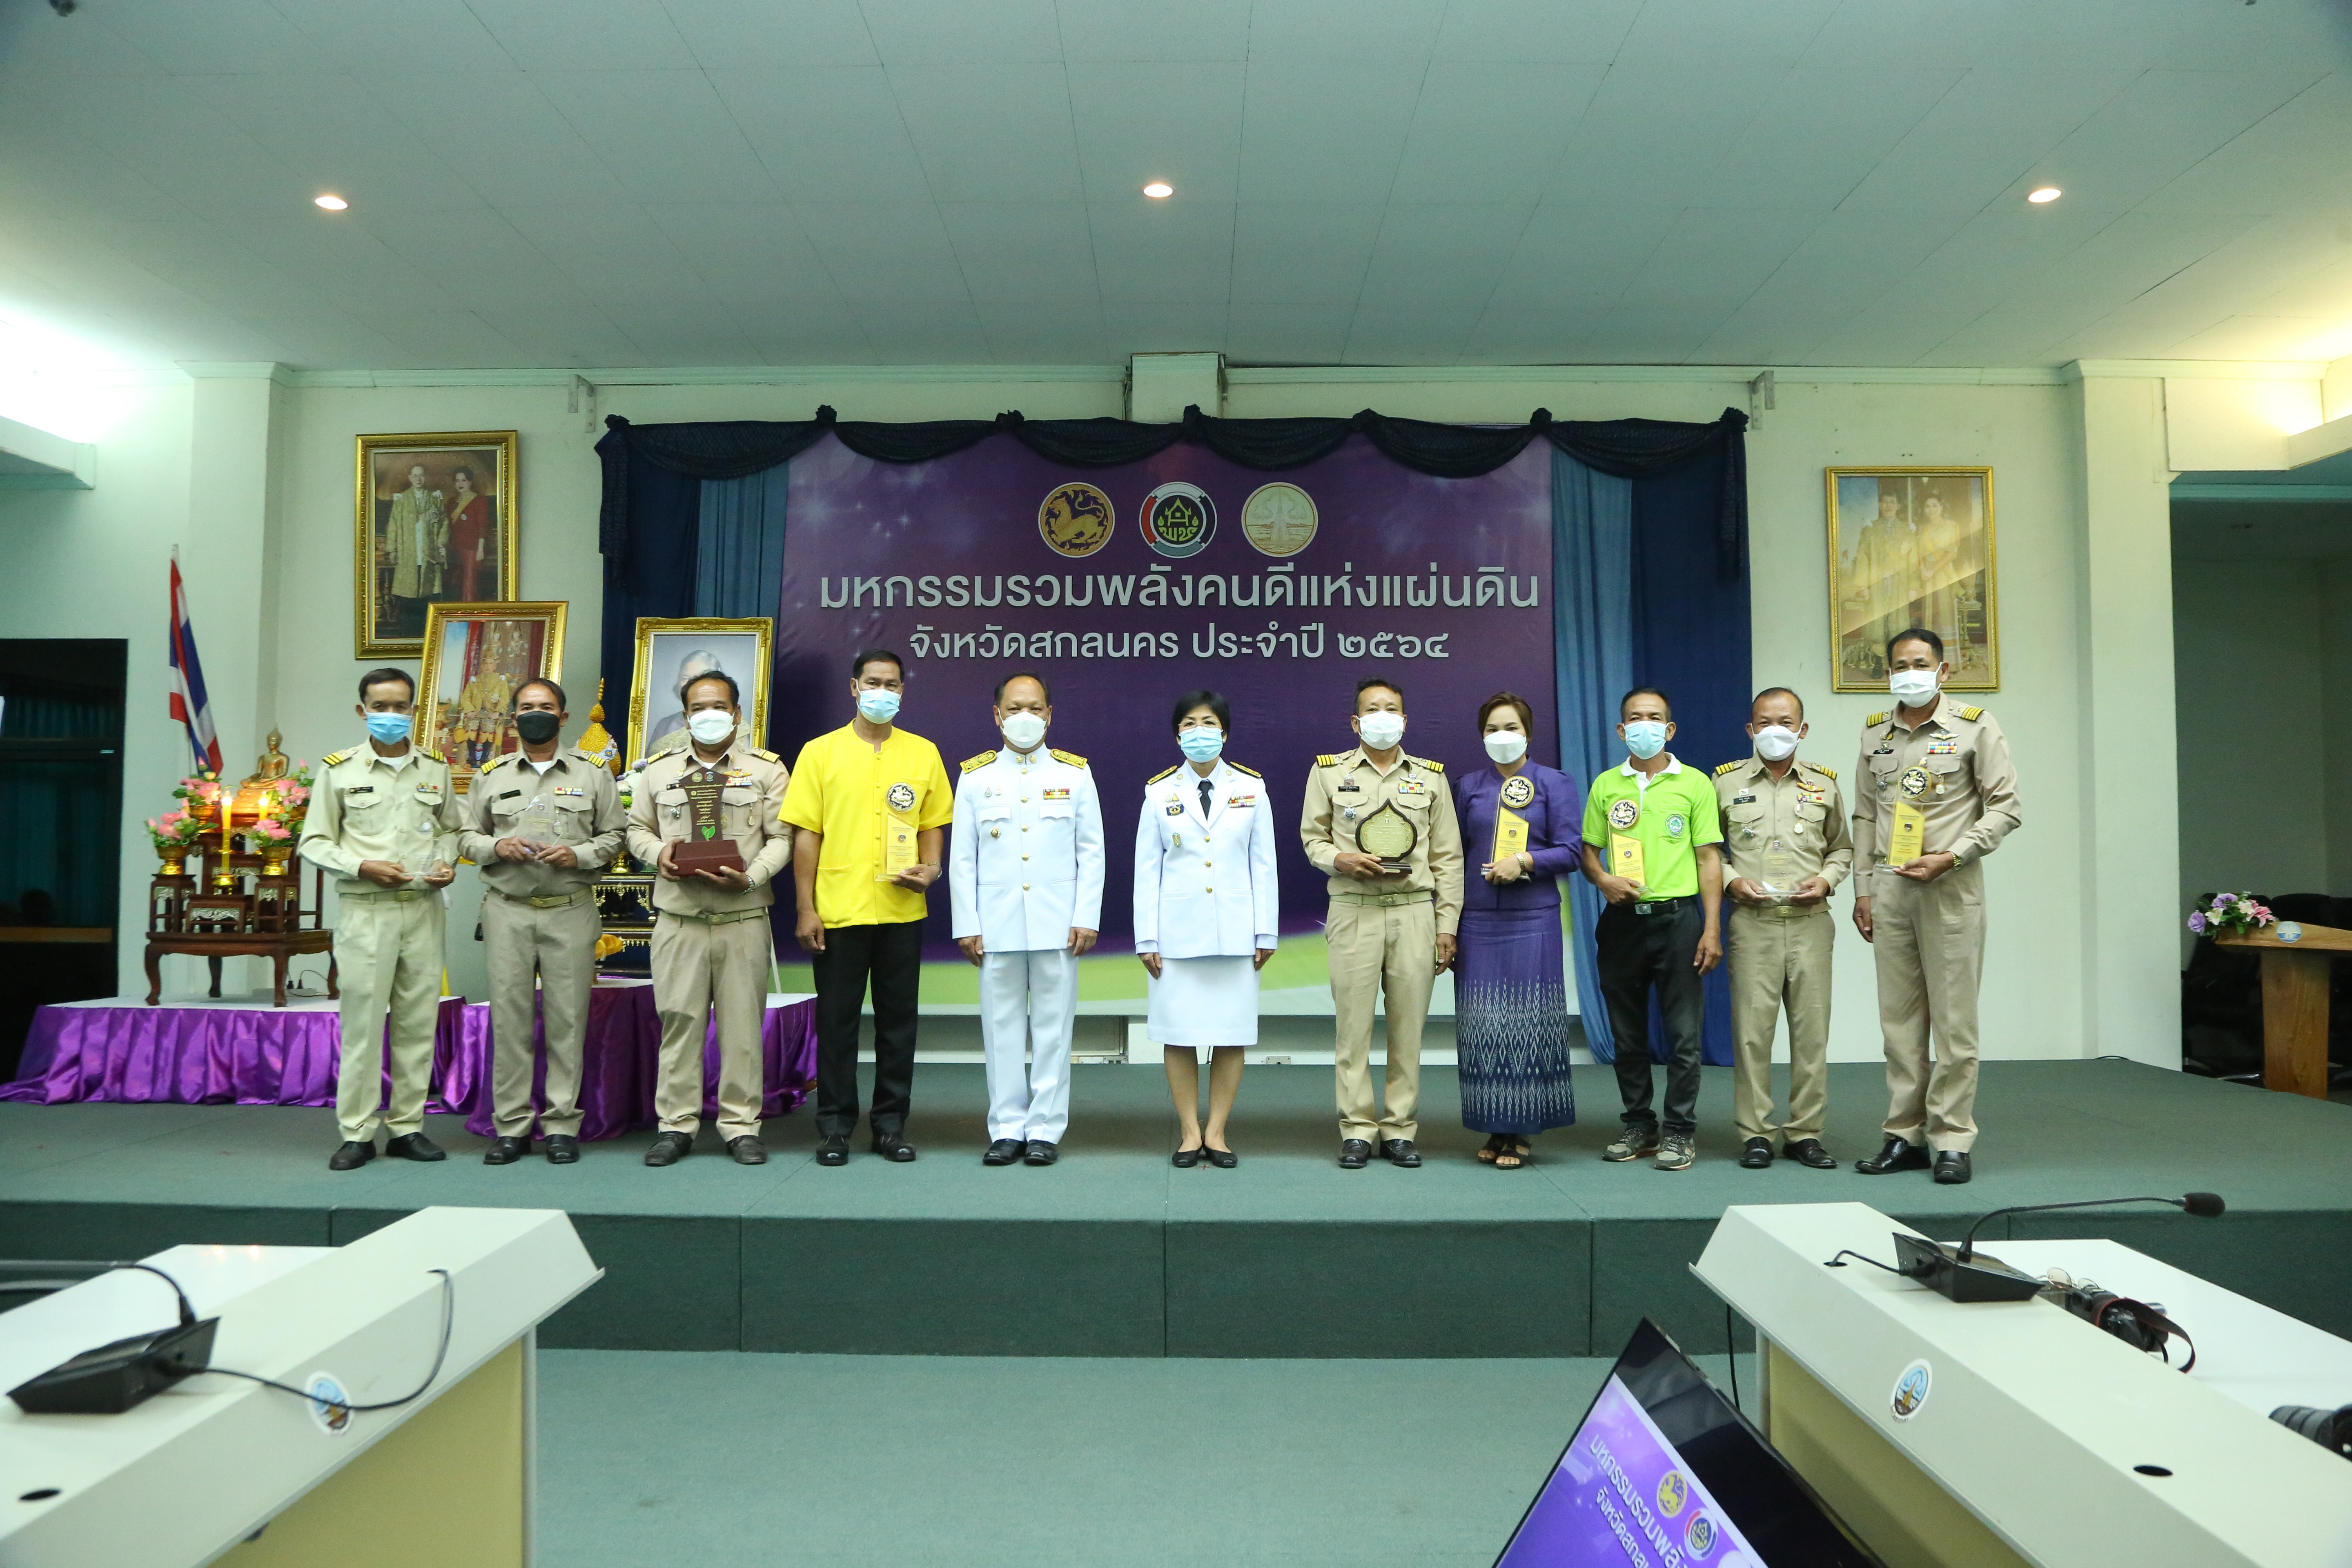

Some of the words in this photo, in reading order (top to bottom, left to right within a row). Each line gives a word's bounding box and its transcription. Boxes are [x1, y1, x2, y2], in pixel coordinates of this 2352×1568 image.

[820, 562, 1538, 608] มหกรรมรวมพลังคนดีแห่งแผ่นดิน
[909, 624, 1179, 658] จังหวัดสกลนคร
[1192, 621, 1324, 658] ประจำปี
[1337, 631, 1449, 658] ๒๕๖๔
[1596, 1486, 1649, 1568] จังหวัดสกล
